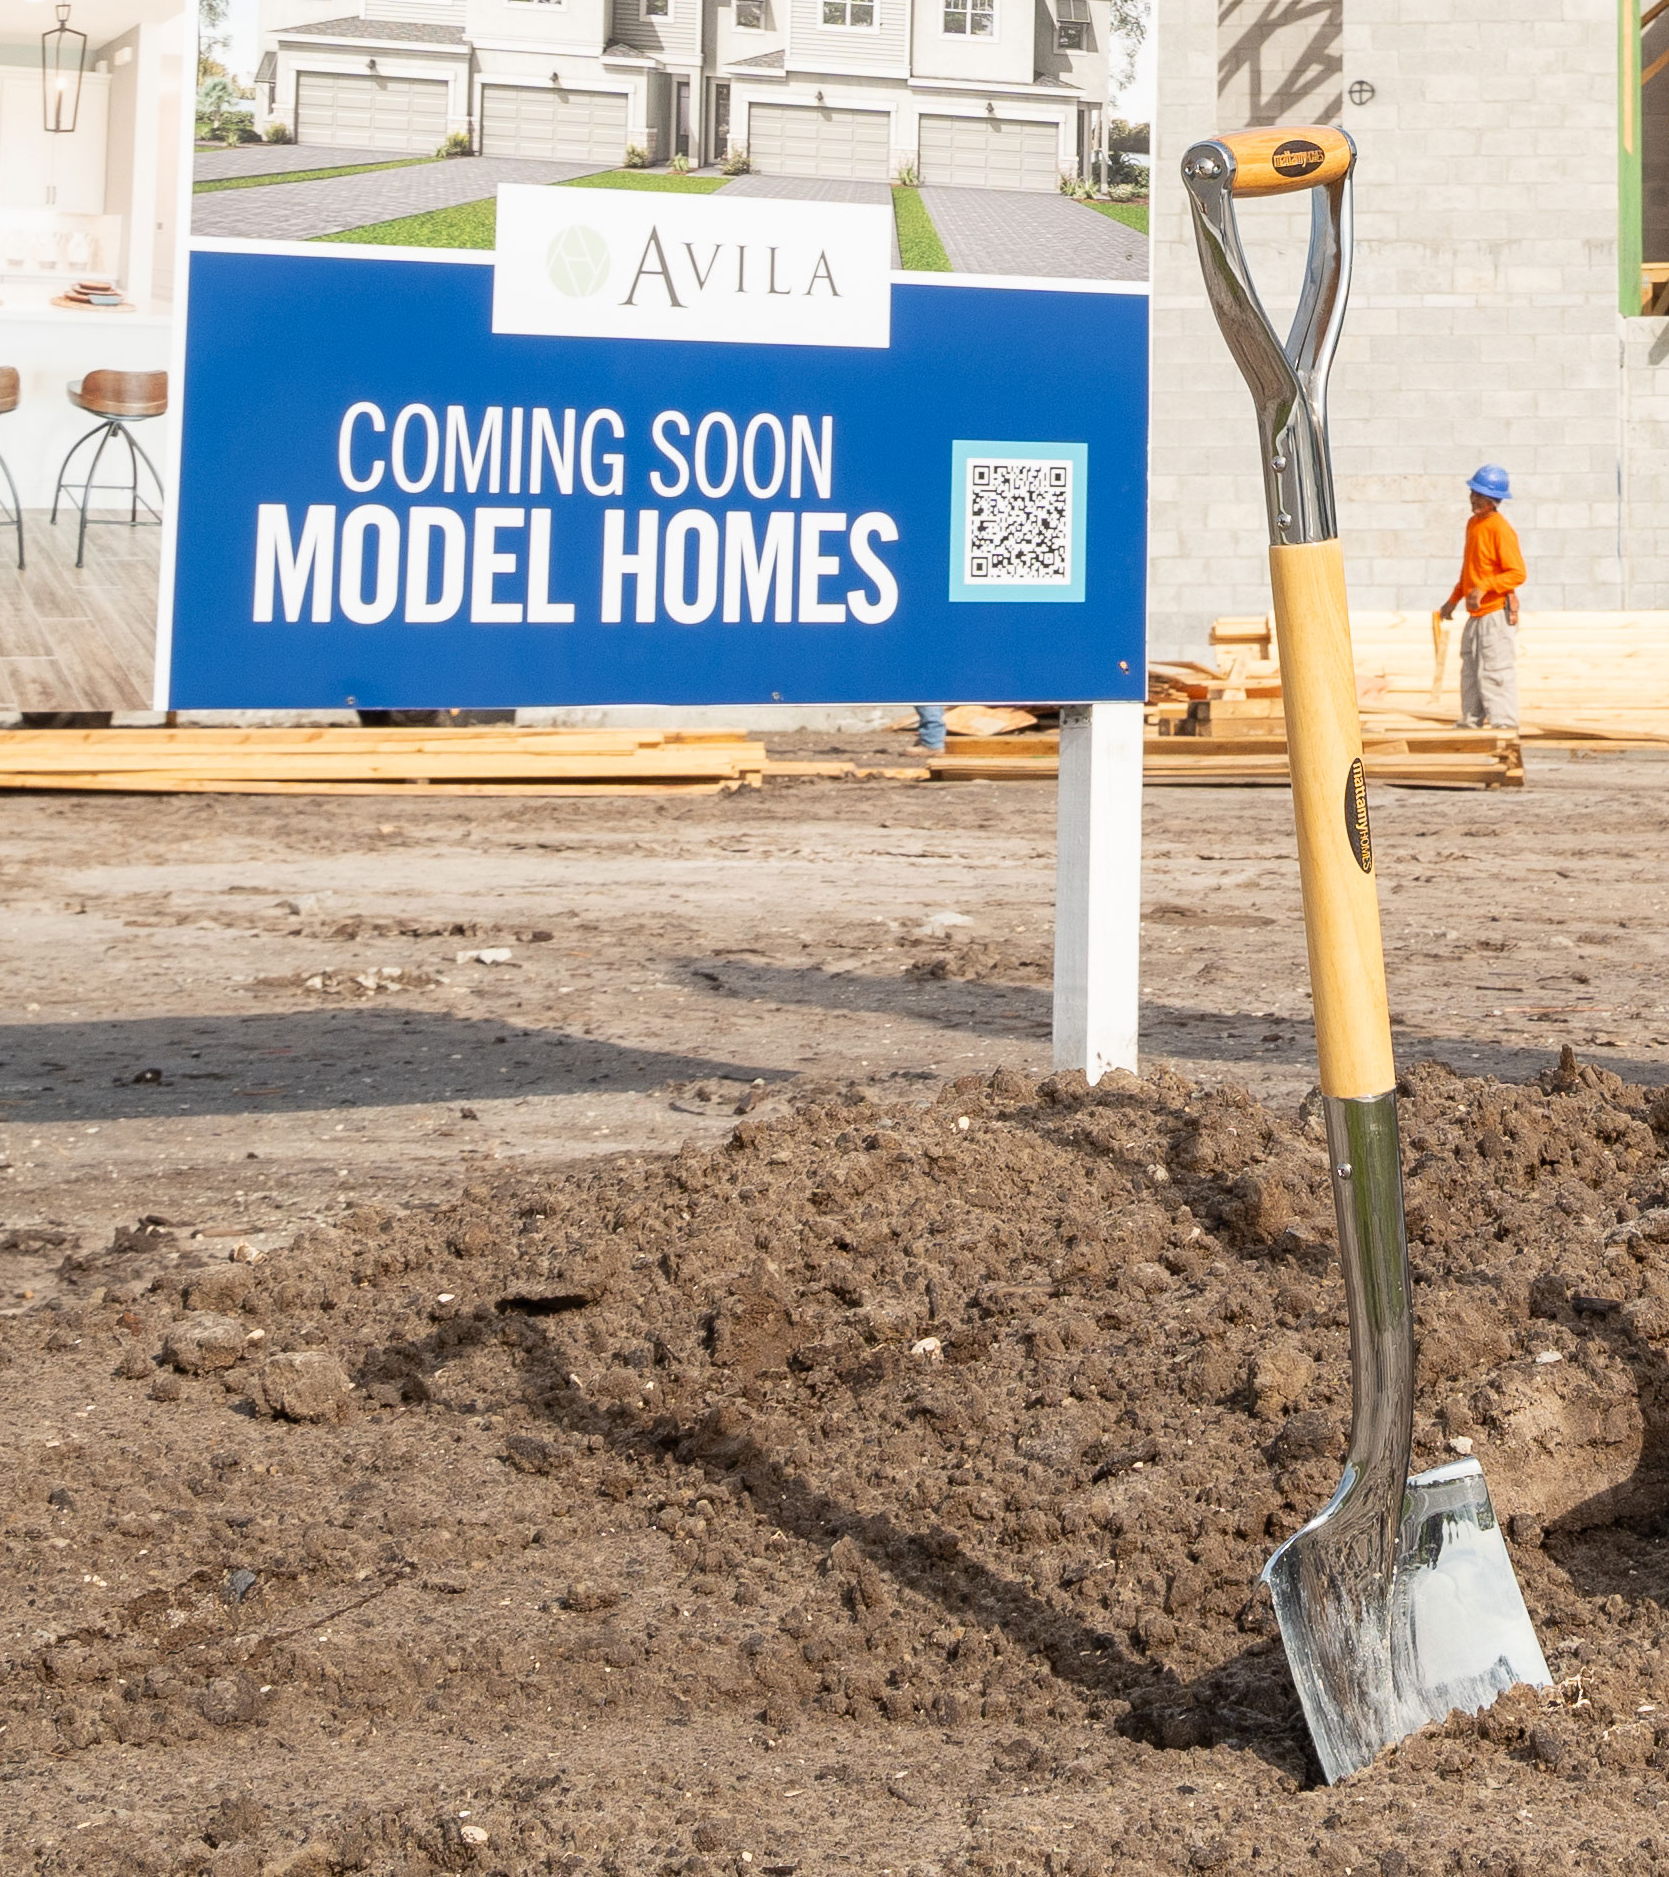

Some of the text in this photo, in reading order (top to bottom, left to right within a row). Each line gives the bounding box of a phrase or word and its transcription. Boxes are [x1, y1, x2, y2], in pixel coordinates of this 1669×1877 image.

[618, 224, 843, 308] AVILA
[337, 401, 834, 499] COMING SOON
[252, 503, 900, 625] MODEL HOMES
